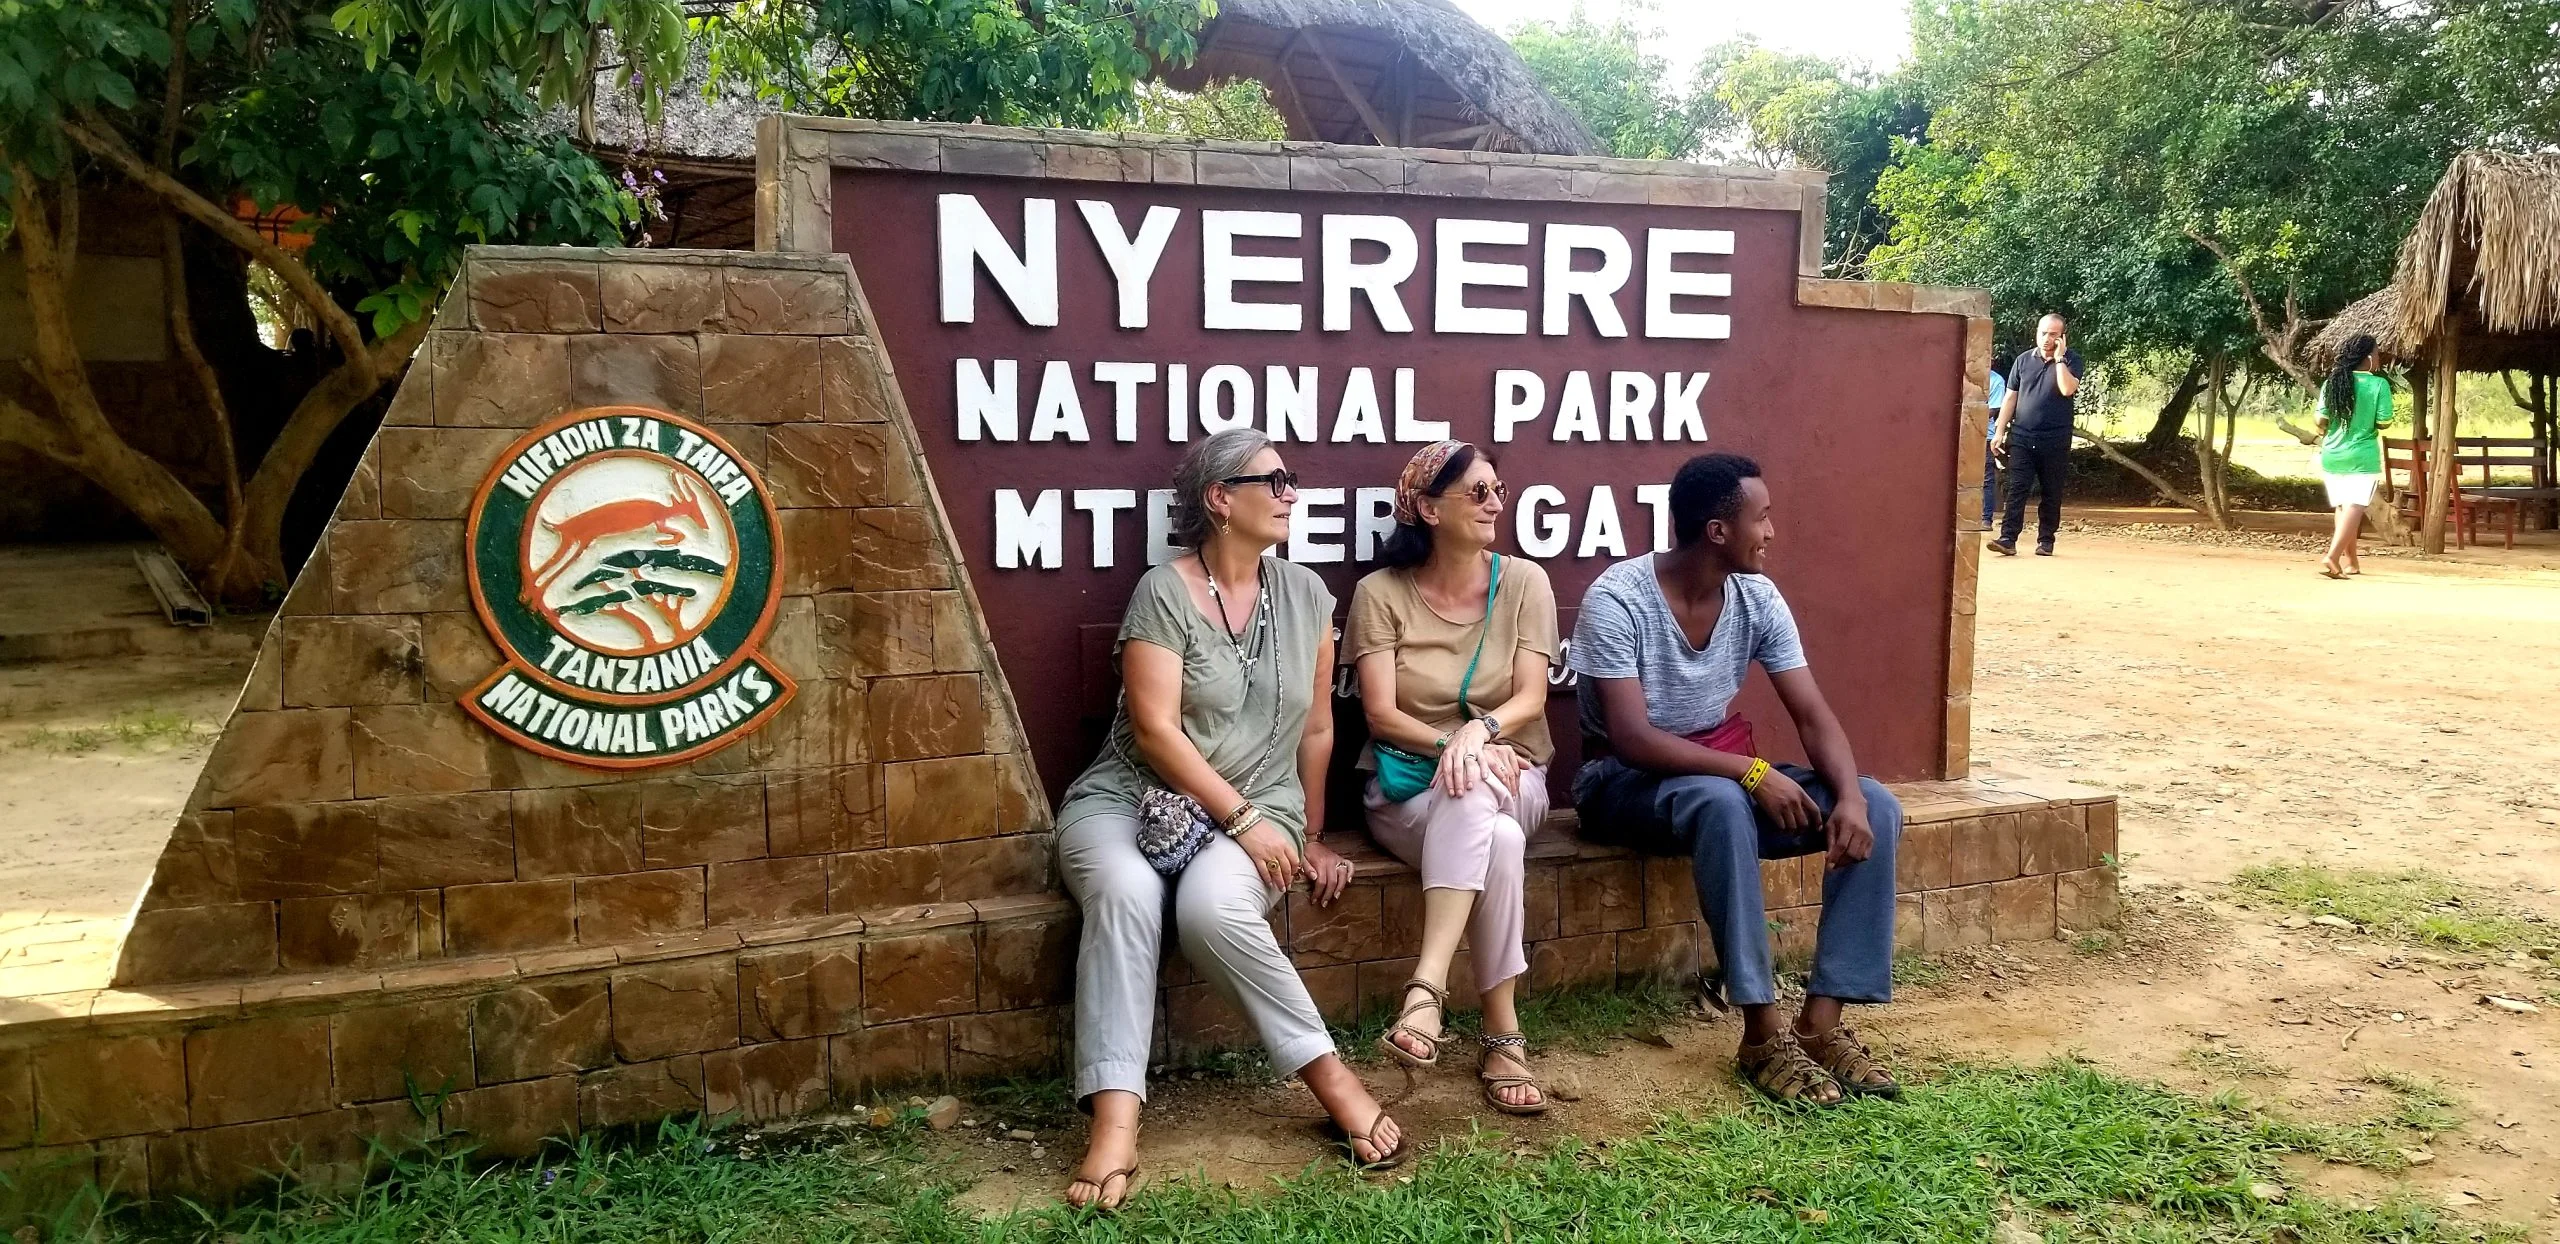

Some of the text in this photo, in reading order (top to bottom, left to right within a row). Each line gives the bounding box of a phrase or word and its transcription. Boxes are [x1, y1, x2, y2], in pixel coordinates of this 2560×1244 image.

[938, 193, 1735, 340] NYERERE
[956, 358, 1711, 443] NATIONAL PARK
[621, 417, 660, 451] ZA
[673, 430, 753, 506] TAIFA
[995, 484, 1672, 568] MTEER GAT
[539, 635, 722, 694] TANZANIA
[481, 665, 774, 754] NATIONAL PARKS
